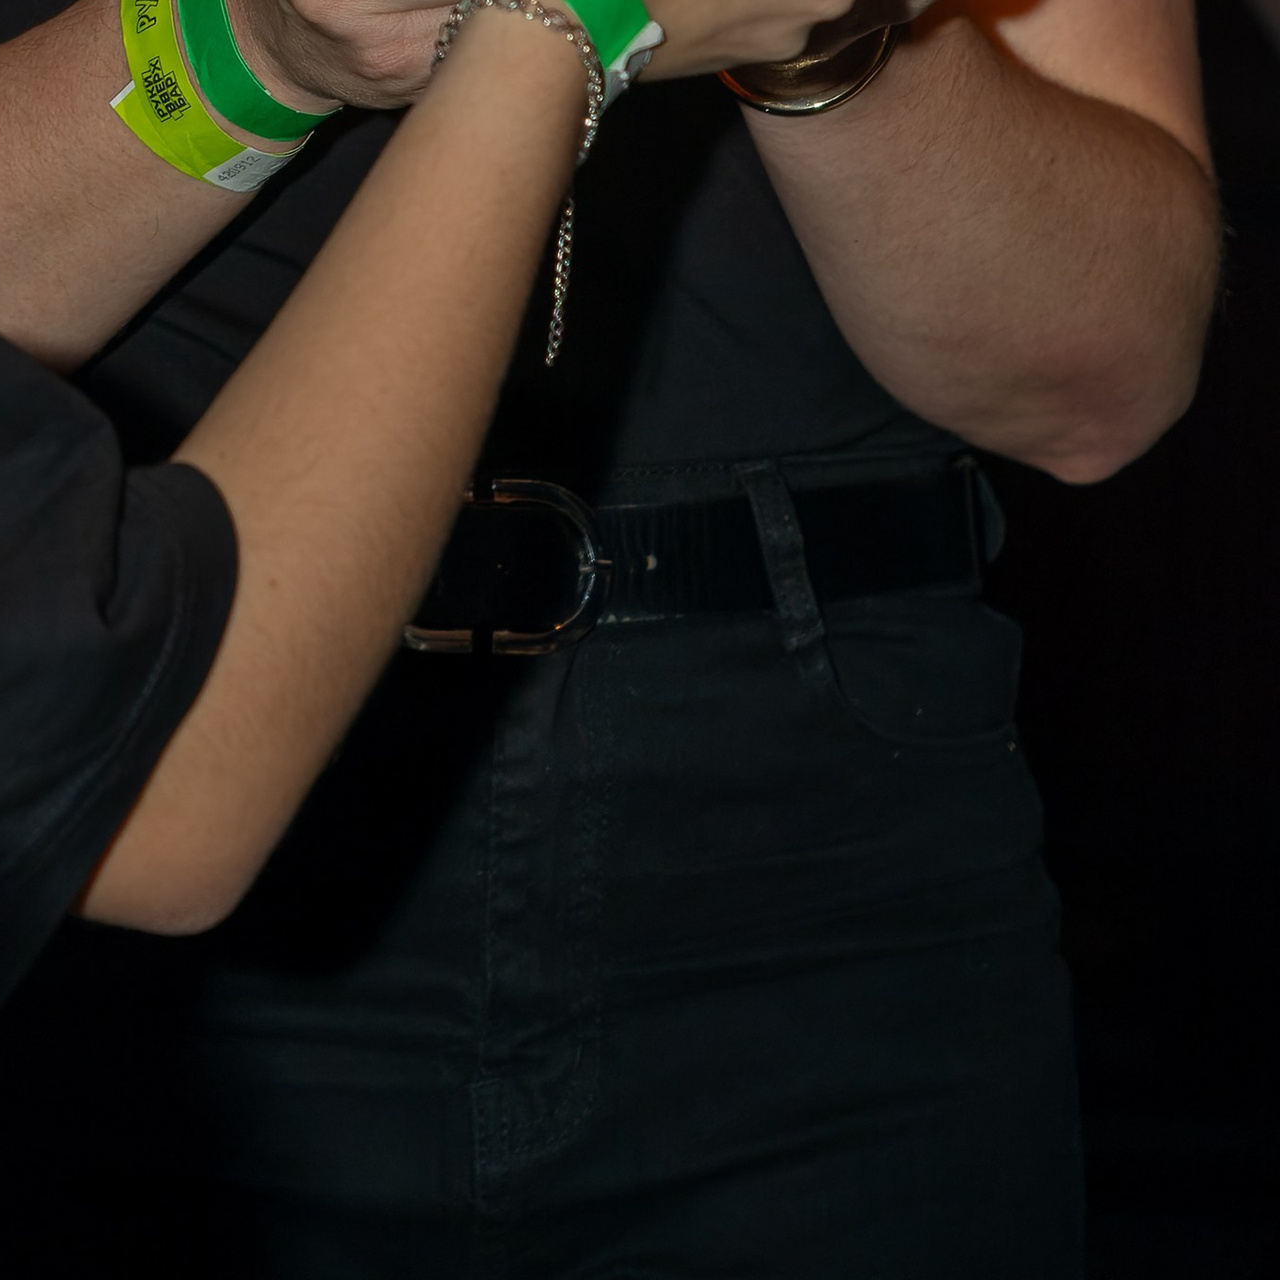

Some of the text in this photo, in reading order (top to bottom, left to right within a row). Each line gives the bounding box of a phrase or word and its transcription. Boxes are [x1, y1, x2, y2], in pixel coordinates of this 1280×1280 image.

[143, 74, 168, 118] РУКИ
[149, 59, 176, 113] ВВЕРХ
[165, 77, 187, 109] БАР
